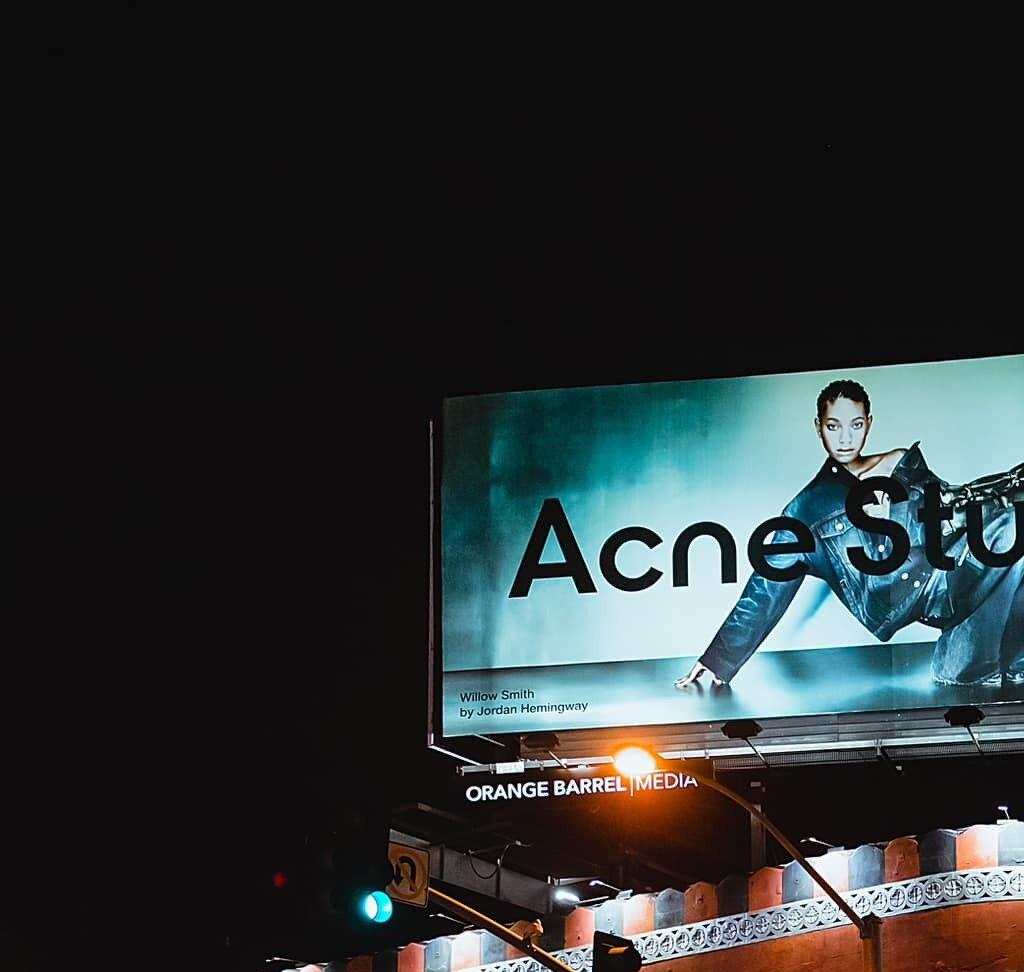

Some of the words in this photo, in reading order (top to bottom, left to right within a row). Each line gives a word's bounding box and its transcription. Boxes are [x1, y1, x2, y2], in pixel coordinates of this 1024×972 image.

[508, 497, 815, 599] Acne
[460, 691, 498, 703] Willow
[501, 689, 535, 700] Smith
[460, 707, 475, 719] by
[476, 705, 518, 717] Jordan
[520, 701, 589, 714] Hemingway
[465, 781, 549, 802] ORANGE
[553, 776, 627, 796] BARREL
[635, 773, 698, 790] MEDIA
